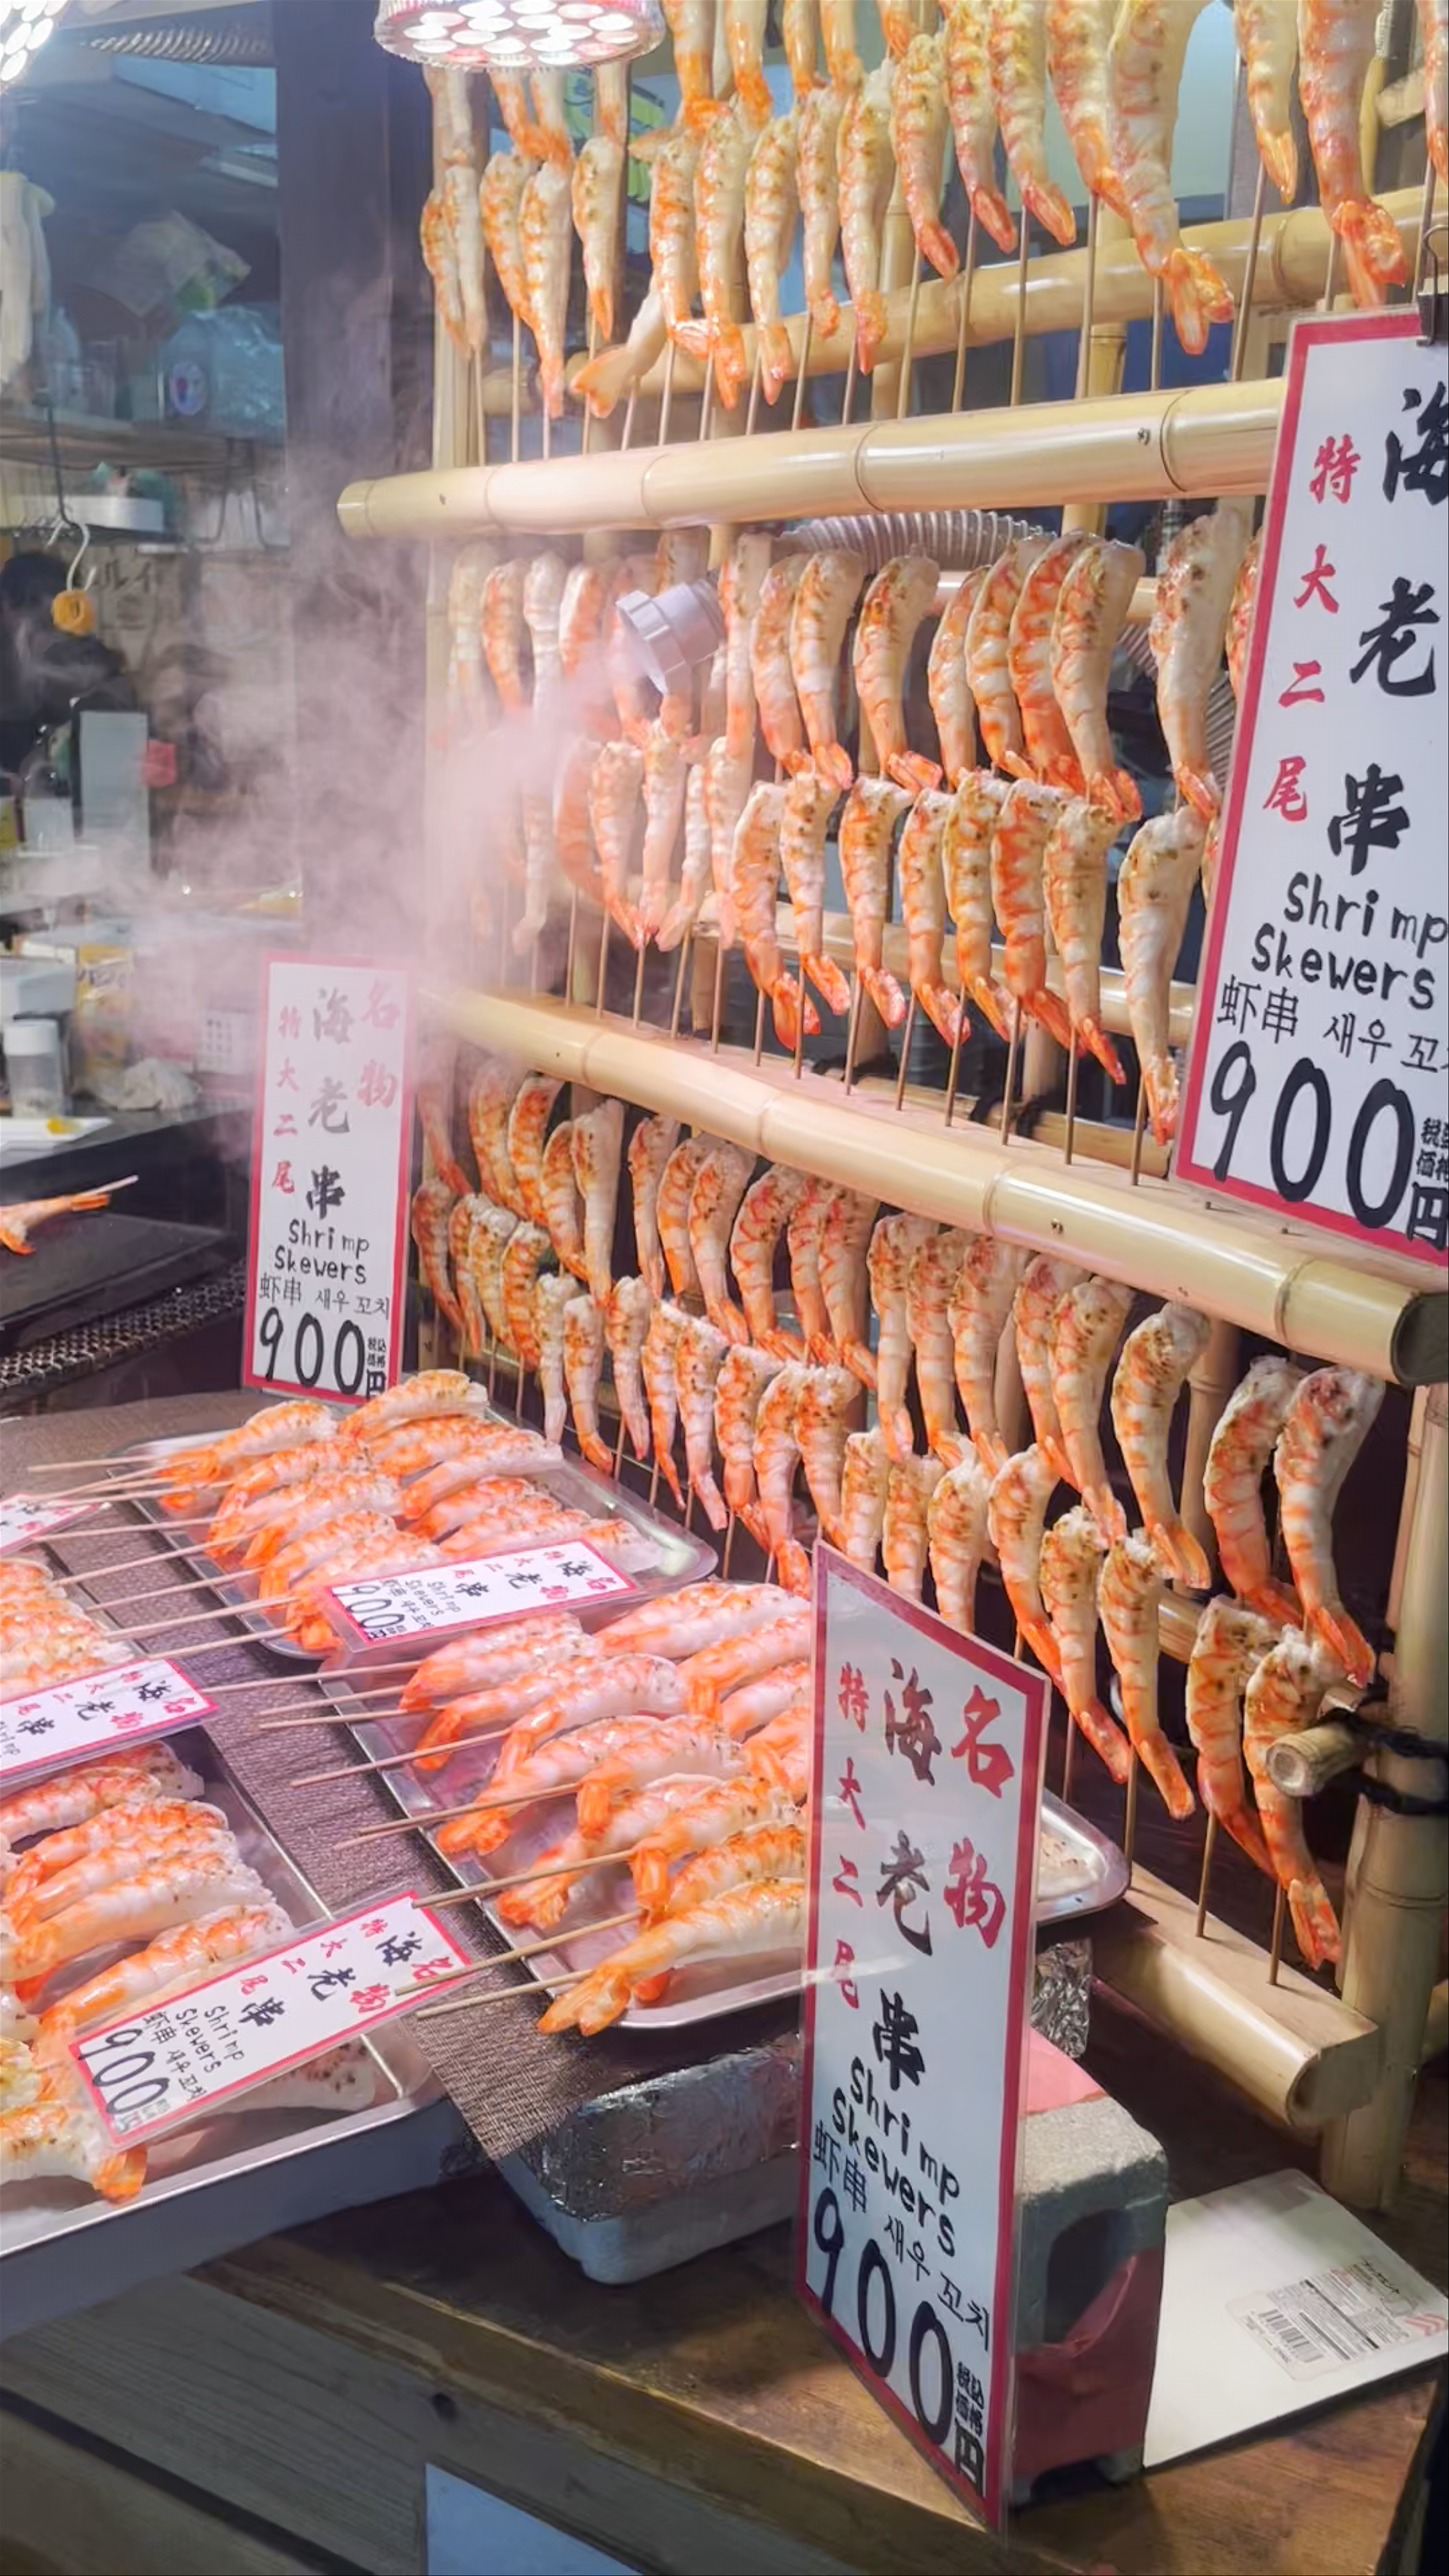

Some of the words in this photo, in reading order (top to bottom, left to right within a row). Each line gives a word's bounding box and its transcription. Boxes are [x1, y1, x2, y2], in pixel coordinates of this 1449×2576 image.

[1263, 434, 1361, 821] 特大二尾
[1284, 872, 1448, 959] Shrimp
[1217, 974, 1299, 1044] 虾串
[1251, 922, 1435, 1010] Skewers
[357, 979, 400, 1109] 名物
[1323, 1012, 1392, 1063] 새우
[1400, 1035, 1449, 1072] 꼬
[271, 1005, 301, 1194] 特大二尾
[306, 987, 354, 1220] 海老串
[1210, 1040, 1415, 1229] 900
[274, 1246, 366, 1284] Skewers
[288, 1219, 369, 1258] Shrimp
[260, 1307, 365, 1395] 900
[332, 1586, 405, 1629] 900
[832, 1662, 870, 2009] 特大二尾
[943, 1684, 1015, 1949] 名物
[872, 1658, 942, 2091] 海老串
[239, 1931, 423, 2027] 海老串
[240, 1919, 388, 1996] 特大二尾
[349, 1956, 454, 2013] 名物
[79, 2027, 170, 2115] 900
[174, 2008, 222, 2074] Skewers
[204, 2005, 245, 2062] Shrimp
[813, 2120, 867, 2213] 虾串
[832, 2087, 955, 2258] Skewers
[850, 2057, 960, 2199] Shrimp
[814, 2187, 953, 2445] 900
[884, 2215, 931, 2281] 새우
[940, 2272, 989, 2351] 꼬치
